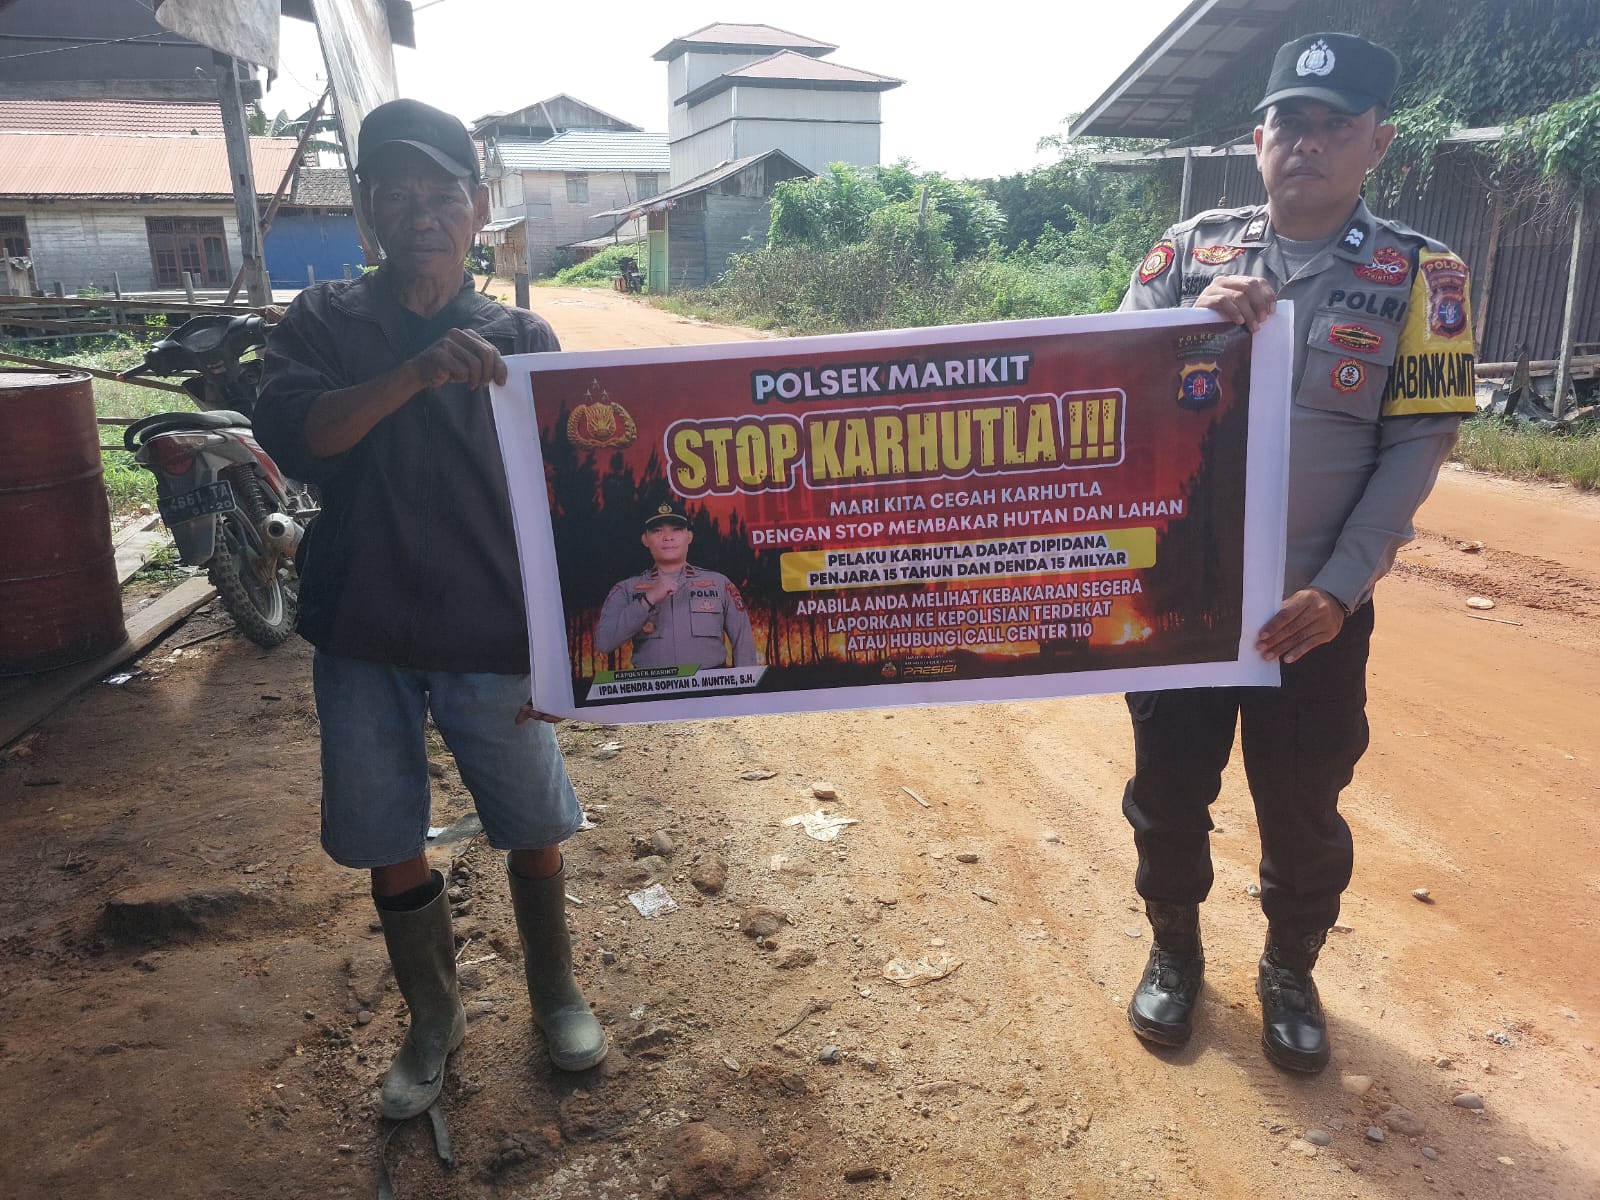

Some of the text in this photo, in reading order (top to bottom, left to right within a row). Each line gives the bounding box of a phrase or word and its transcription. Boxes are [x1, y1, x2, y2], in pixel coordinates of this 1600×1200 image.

[1426, 260, 1465, 273] POLDA
[1328, 289, 1407, 322] POLRI
[755, 355, 1030, 400] POLSEK MARIKIT
[674, 398, 1117, 489] STOP KARHUTLA !!!
[830, 481, 1102, 516] MARI KITA CEGAH KARHUTLA
[752, 499, 1183, 545] DENGAN STOP MEMBAKAR HUTAN DAN LAHAN
[828, 535, 1107, 567] PELAKU KARHUTLA DAPAT DIPIDANA
[809, 552, 1126, 586] PENJARA 15 TAHUN DAN DENDA 15 MILYAR
[690, 590, 719, 598] POLRI
[796, 579, 1143, 616] APABILA ANDA MELIHAT KEBAKARAN SEGERA
[828, 600, 1112, 633] LAPORKAN KE KEPOLISIAN TERDEKAT
[847, 622, 1092, 651] ATAU HUBUNGI CALL CENTER 110
[598, 673, 756, 696] IPDA HENDRA SOPIYAN D. MUNTHE, S.H.
[615, 668, 678, 680] KAPOLSEK MARIKIT
[904, 664, 957, 676] PRESISI
